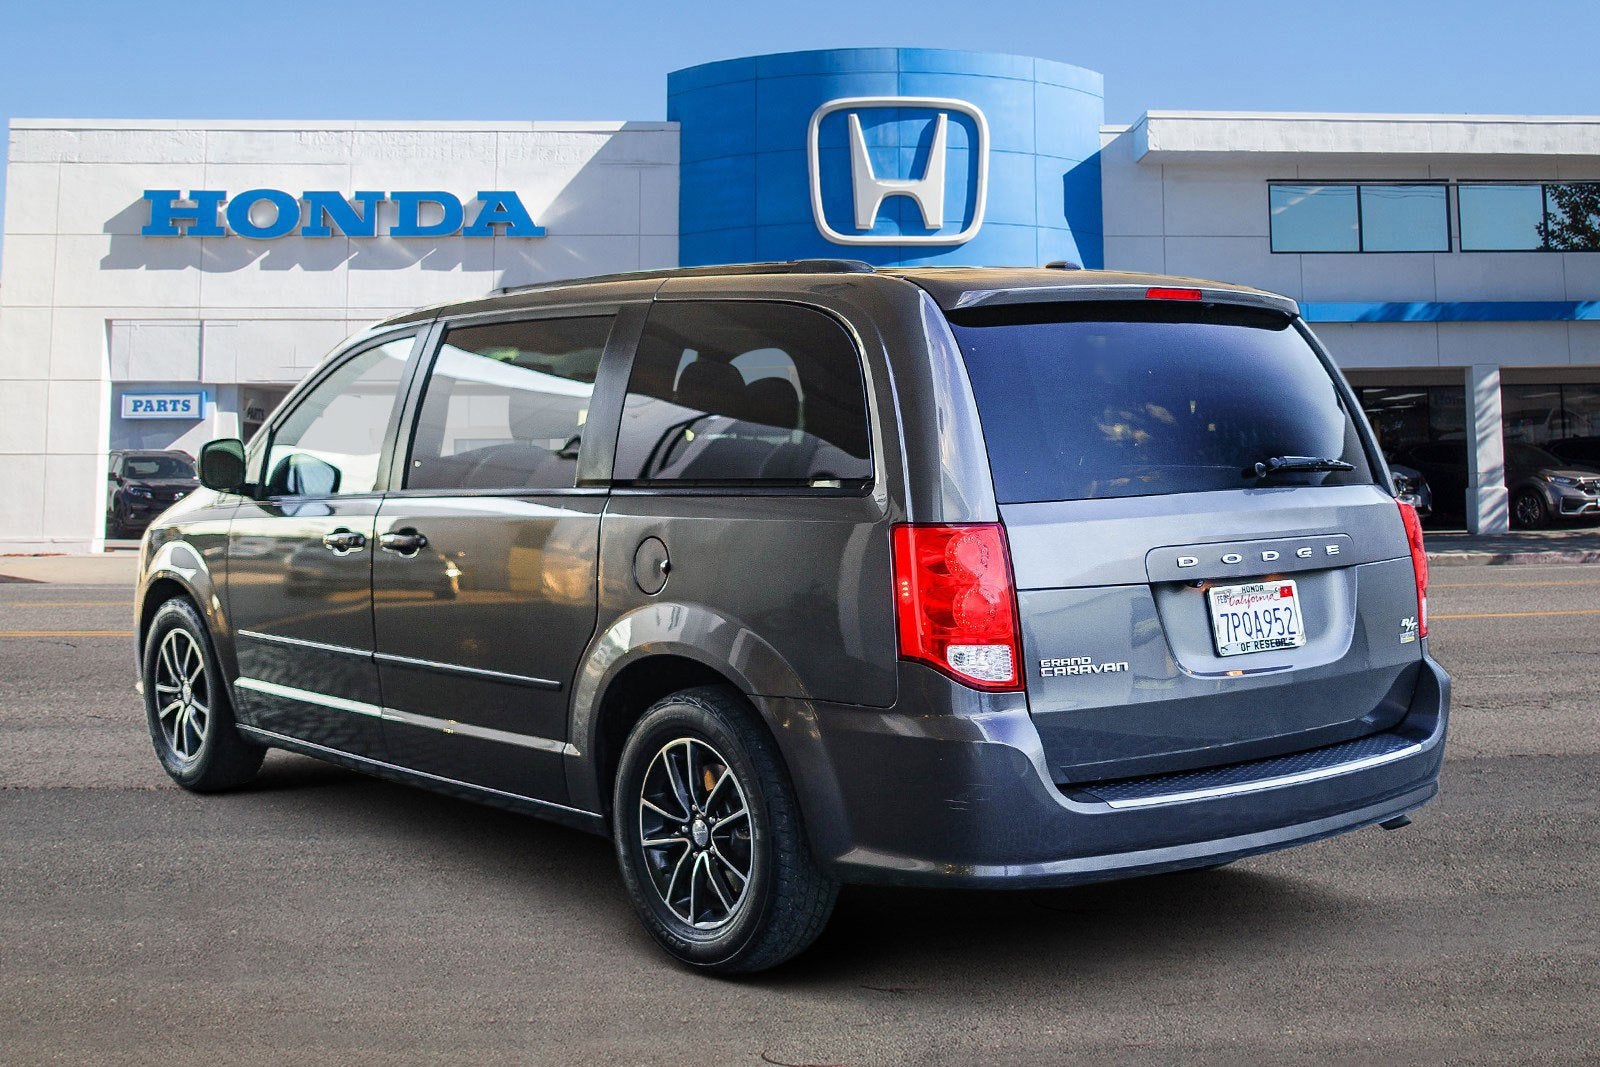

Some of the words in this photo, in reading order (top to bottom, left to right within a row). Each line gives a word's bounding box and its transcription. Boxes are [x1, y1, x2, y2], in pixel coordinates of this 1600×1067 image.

[141, 188, 547, 239] HONDA
[132, 399, 191, 412] PARTS
[1177, 544, 1340, 568] DODGE
[1228, 593, 1280, 609] California
[1240, 642, 1251, 652] OF
[1040, 661, 1129, 678] CARAVAN
[1041, 656, 1092, 668] GRAND
